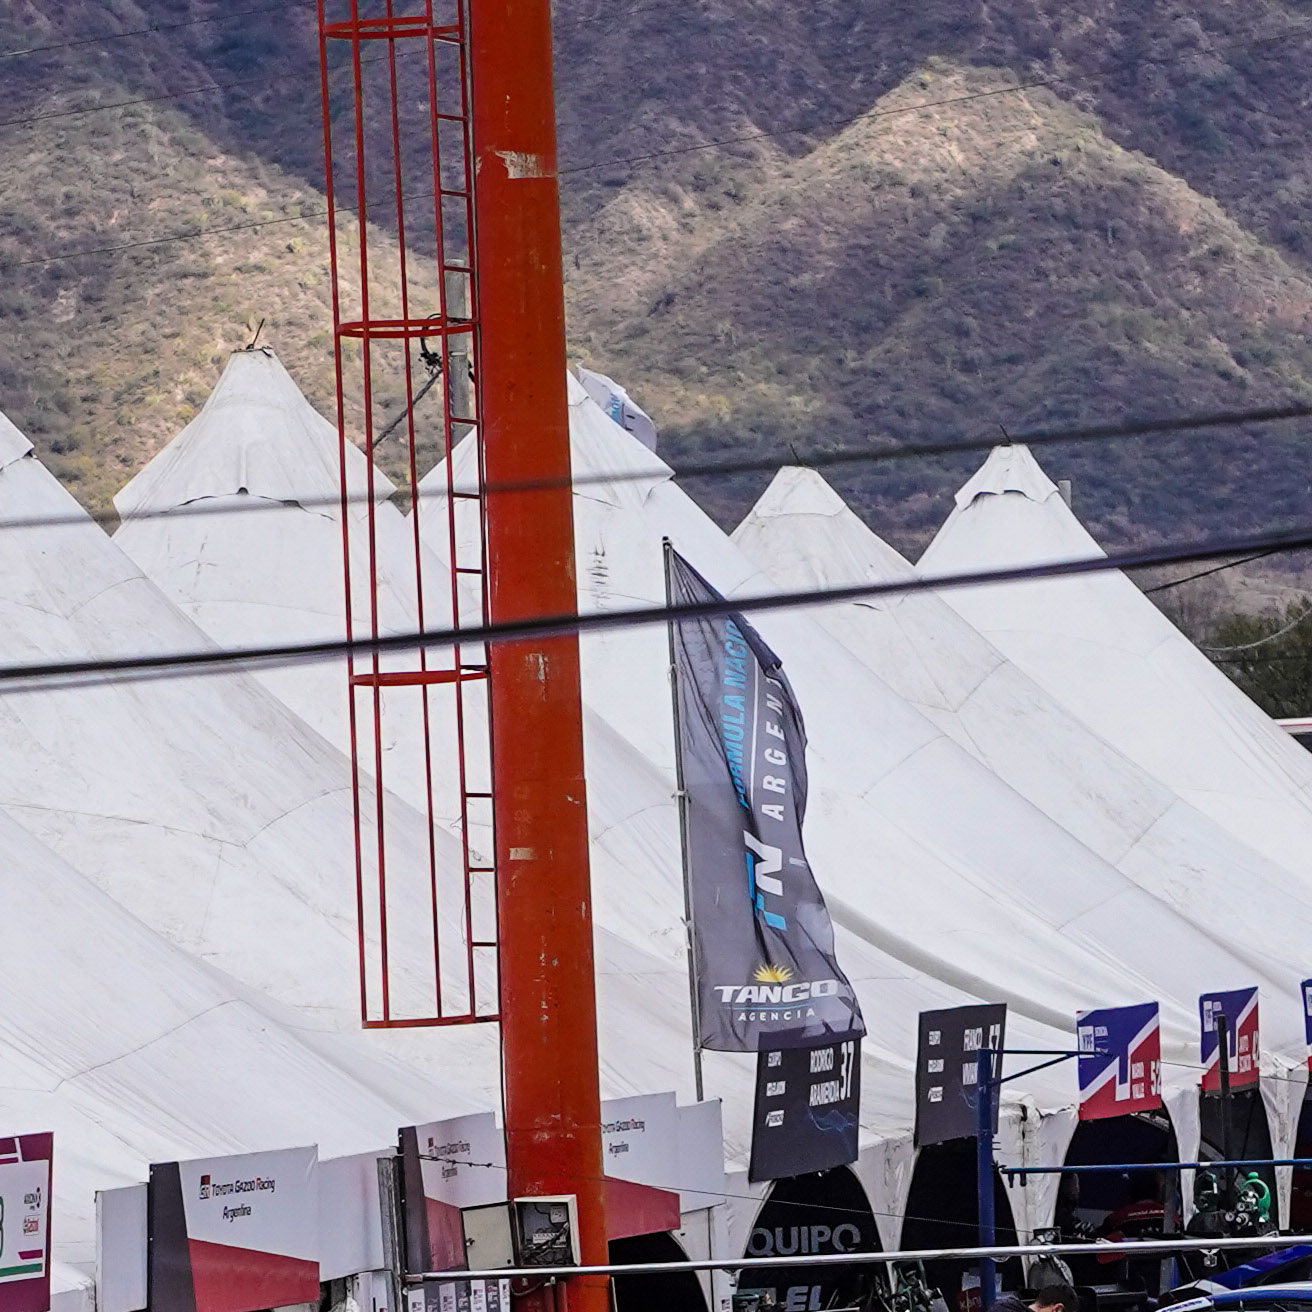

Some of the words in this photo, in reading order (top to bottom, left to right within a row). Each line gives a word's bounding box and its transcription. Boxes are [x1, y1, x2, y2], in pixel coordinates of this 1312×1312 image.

[714, 979, 838, 1004] TANGO
[738, 1008, 815, 1022] AGENCIA
[841, 1041, 855, 1100] 37
[212, 1182, 234, 1197] TOYOTA
[256, 1176, 275, 1193] Racing
[749, 1223, 862, 1257] QUIPO
